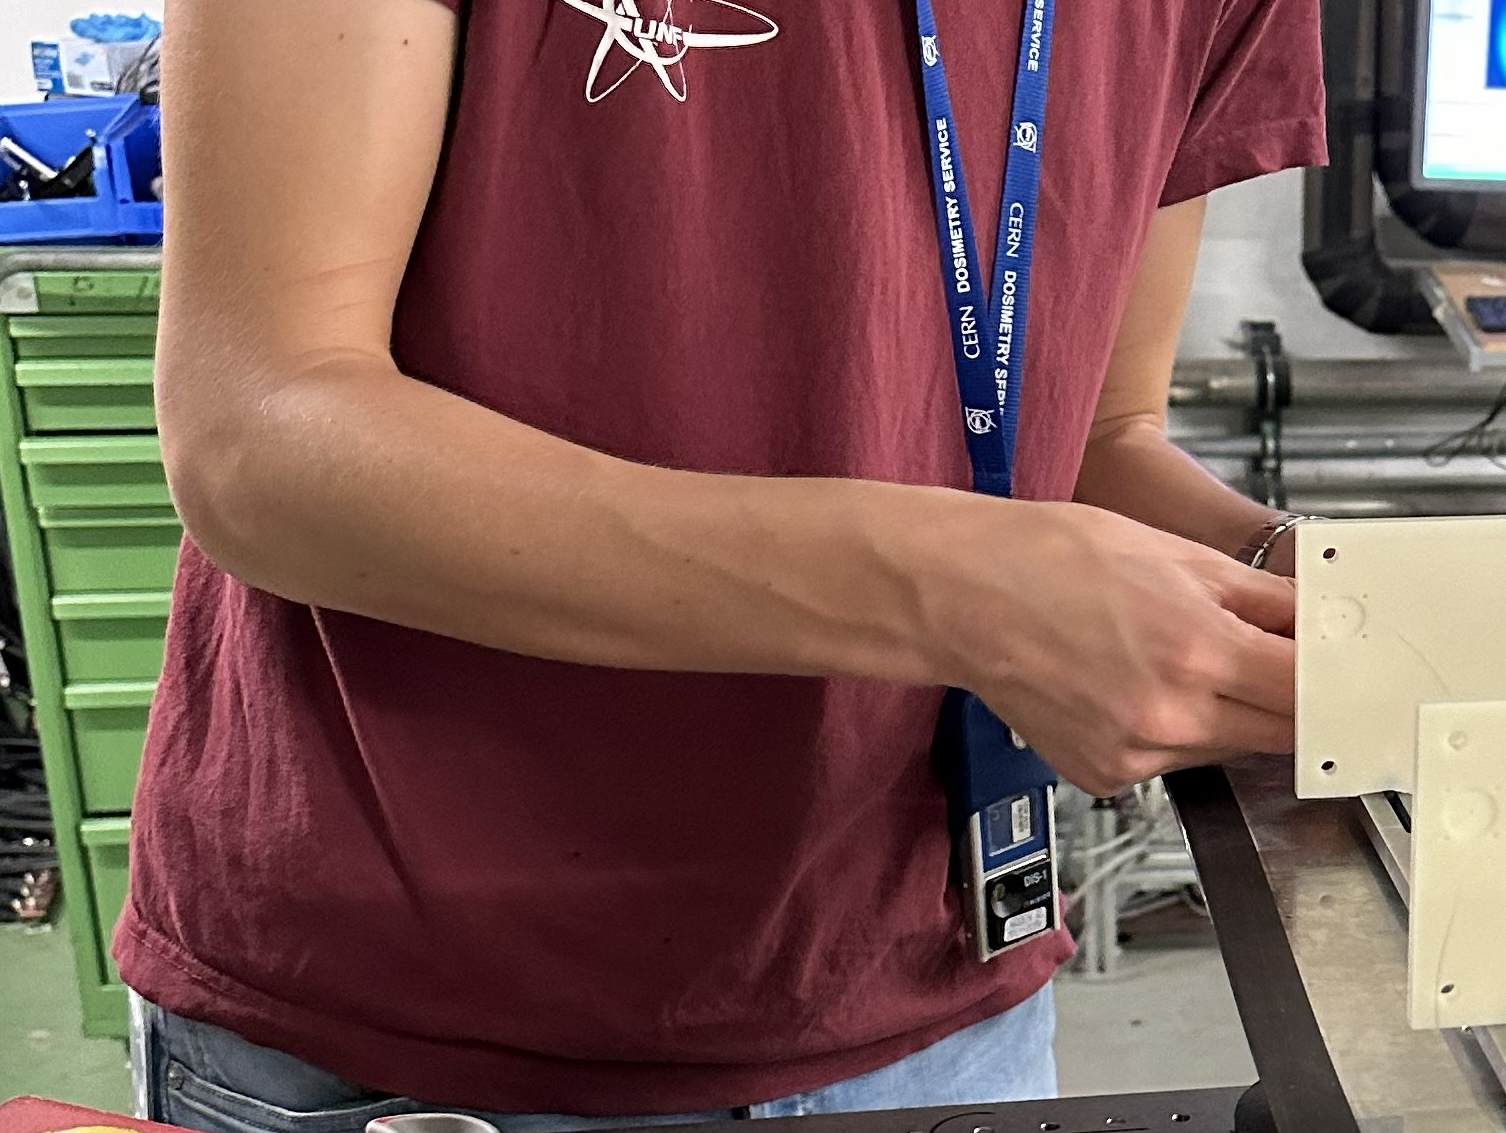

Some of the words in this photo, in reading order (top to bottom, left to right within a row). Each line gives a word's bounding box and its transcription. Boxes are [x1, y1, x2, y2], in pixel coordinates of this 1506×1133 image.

[633, 17, 683, 46] UNF
[935, 117, 956, 193] SERVICE
[945, 196, 971, 294] DOSIMETRY
[1006, 202, 1025, 258] CERN
[958, 305, 981, 360] CERN
[996, 270, 1017, 366] DOSIMETRY
